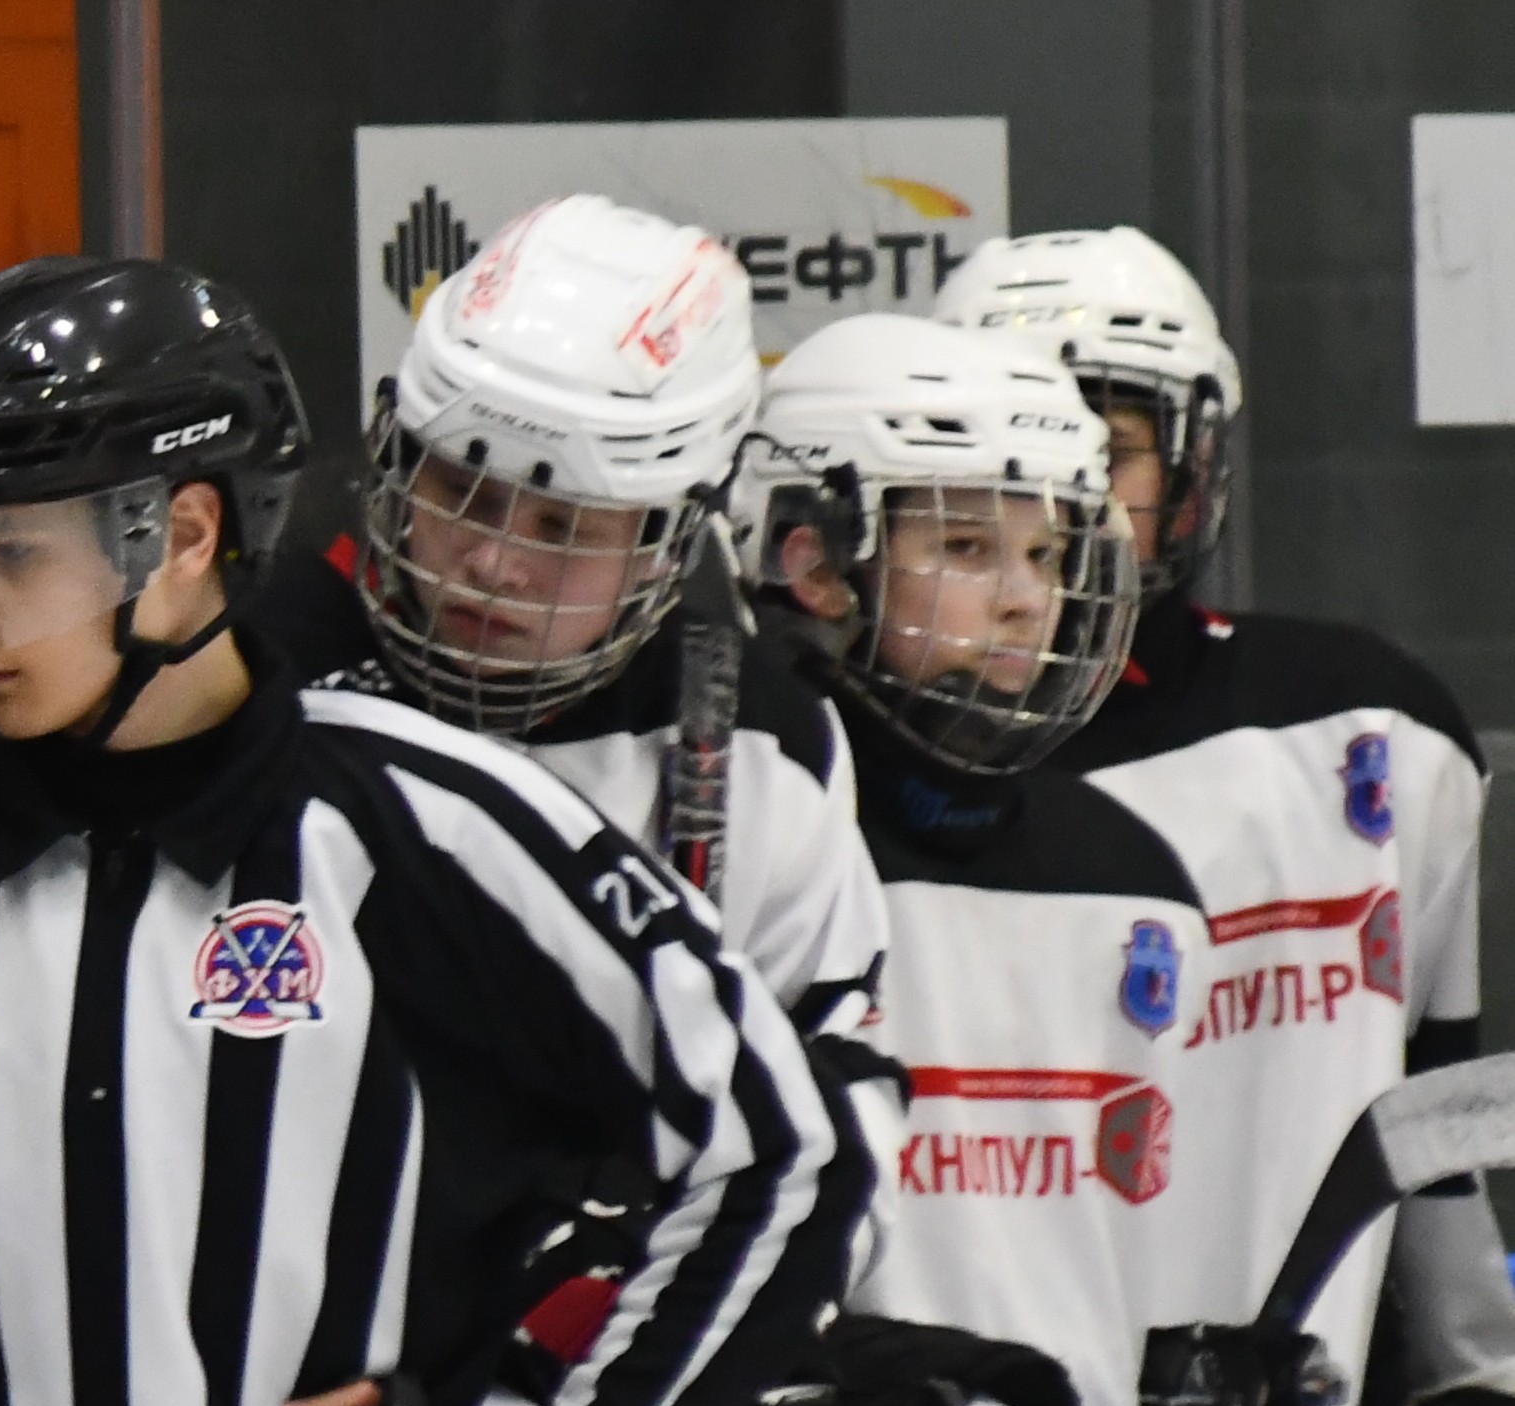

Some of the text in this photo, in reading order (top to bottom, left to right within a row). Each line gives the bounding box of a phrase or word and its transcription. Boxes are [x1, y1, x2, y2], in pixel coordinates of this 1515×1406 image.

[151, 413, 232, 454] CCM
[591, 854, 680, 939] 21
[1184, 963, 1356, 1049] ПУЛ-Р
